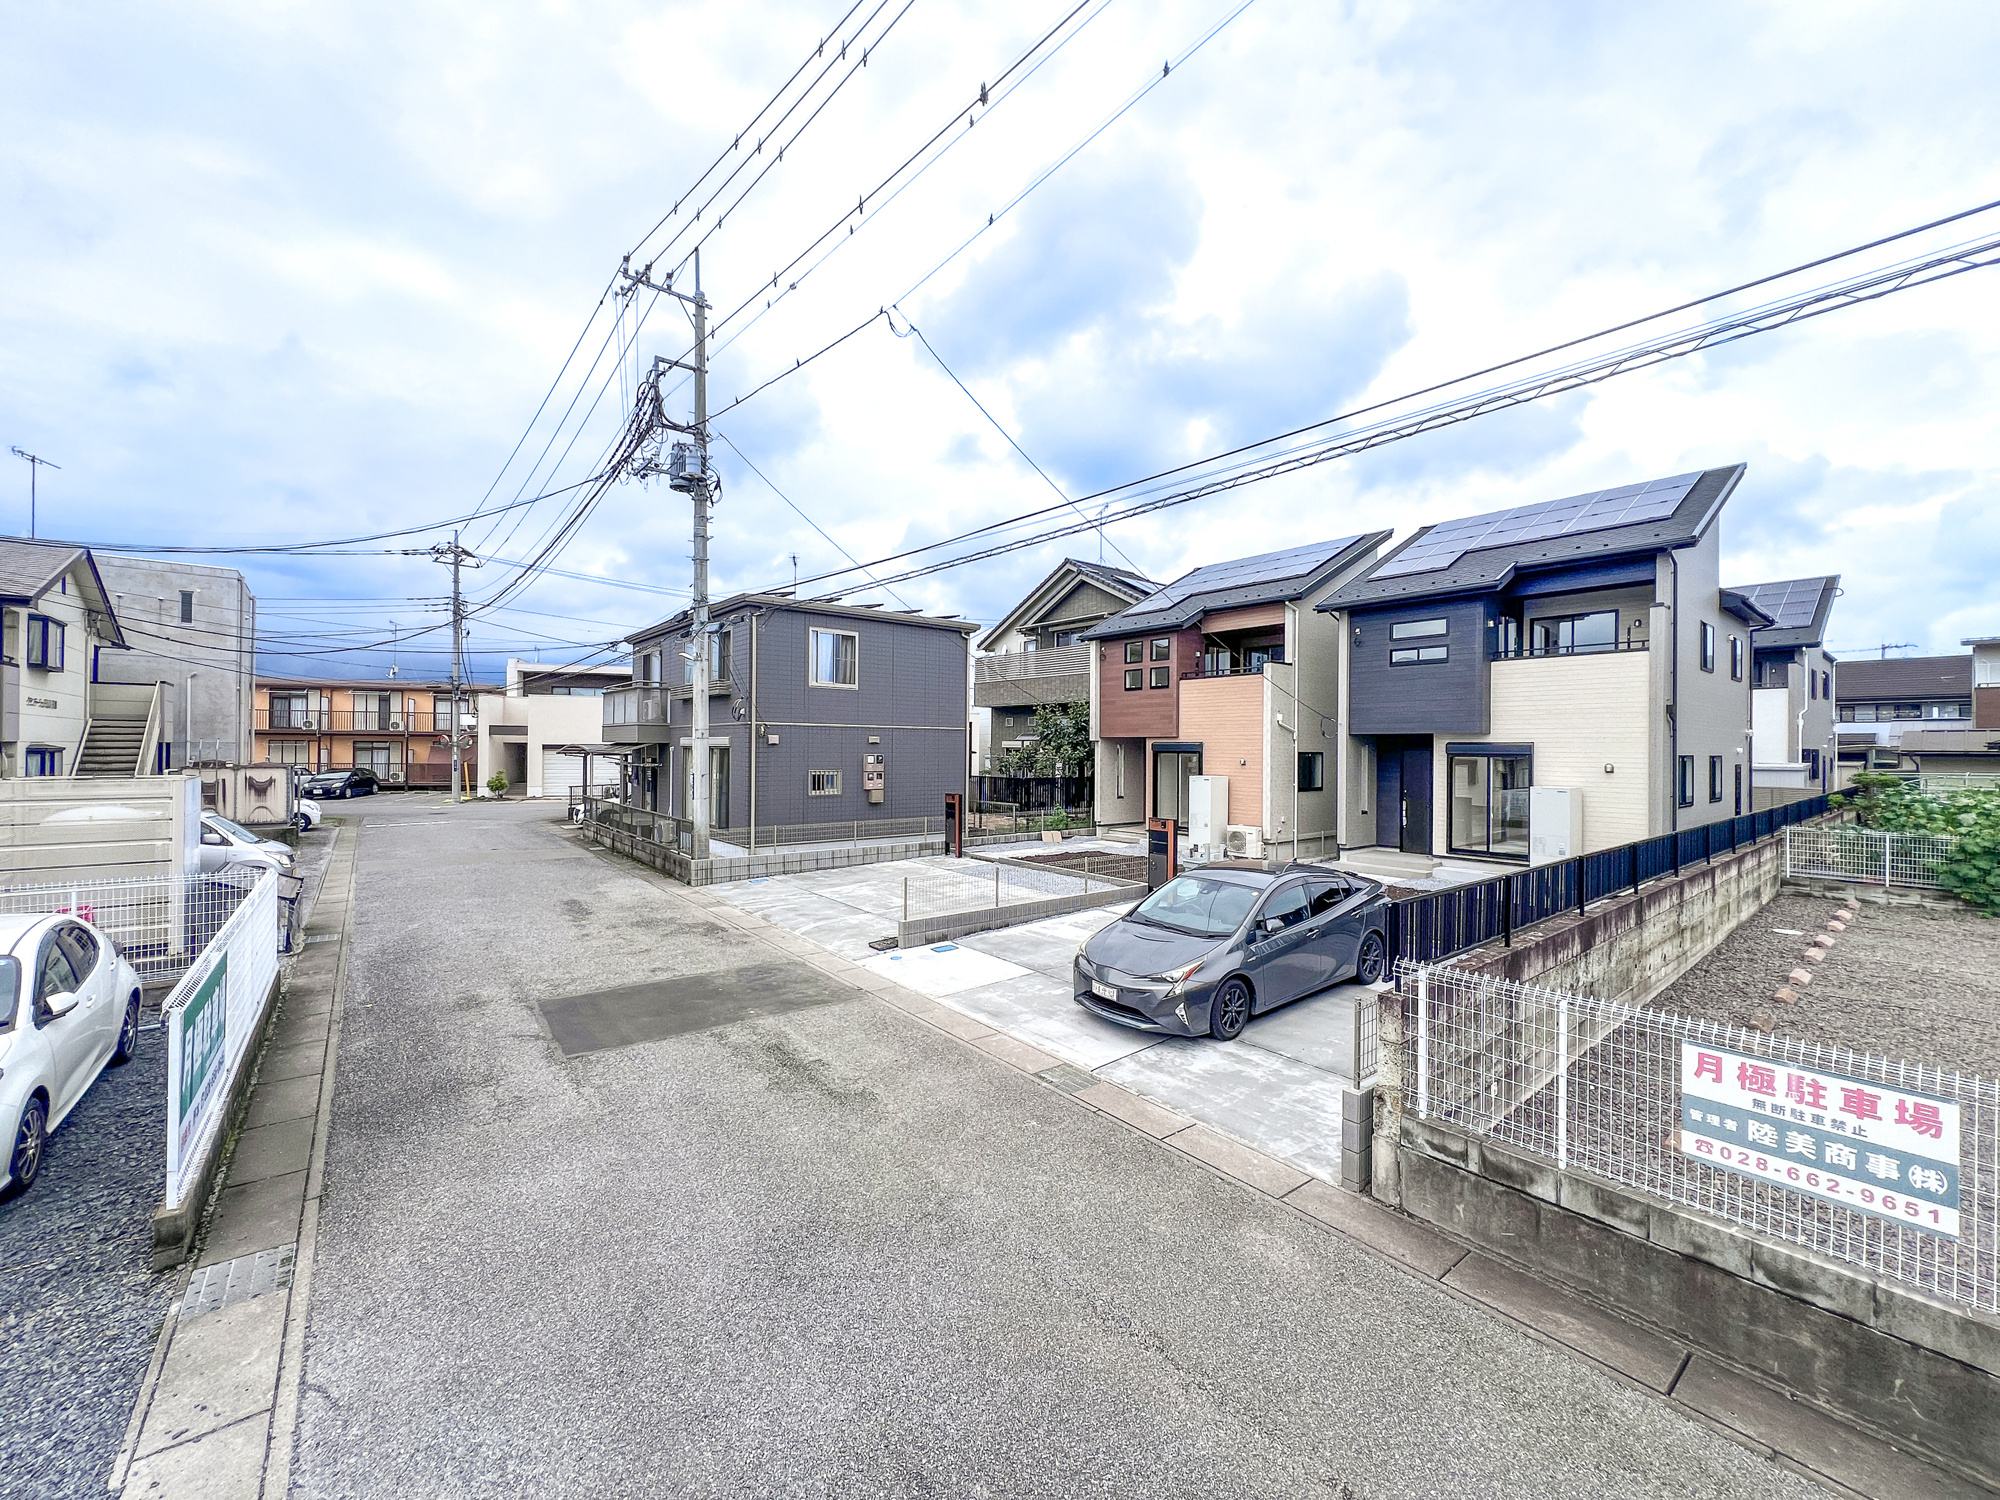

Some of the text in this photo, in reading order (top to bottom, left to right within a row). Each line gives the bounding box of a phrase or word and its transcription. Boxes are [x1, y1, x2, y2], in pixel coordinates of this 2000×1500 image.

[1694, 1052, 1943, 1139] 月極駐車場
[1752, 1098, 1868, 1138] 無断駐車禁止
[1720, 1146, 1940, 1224] 028-662-9651
